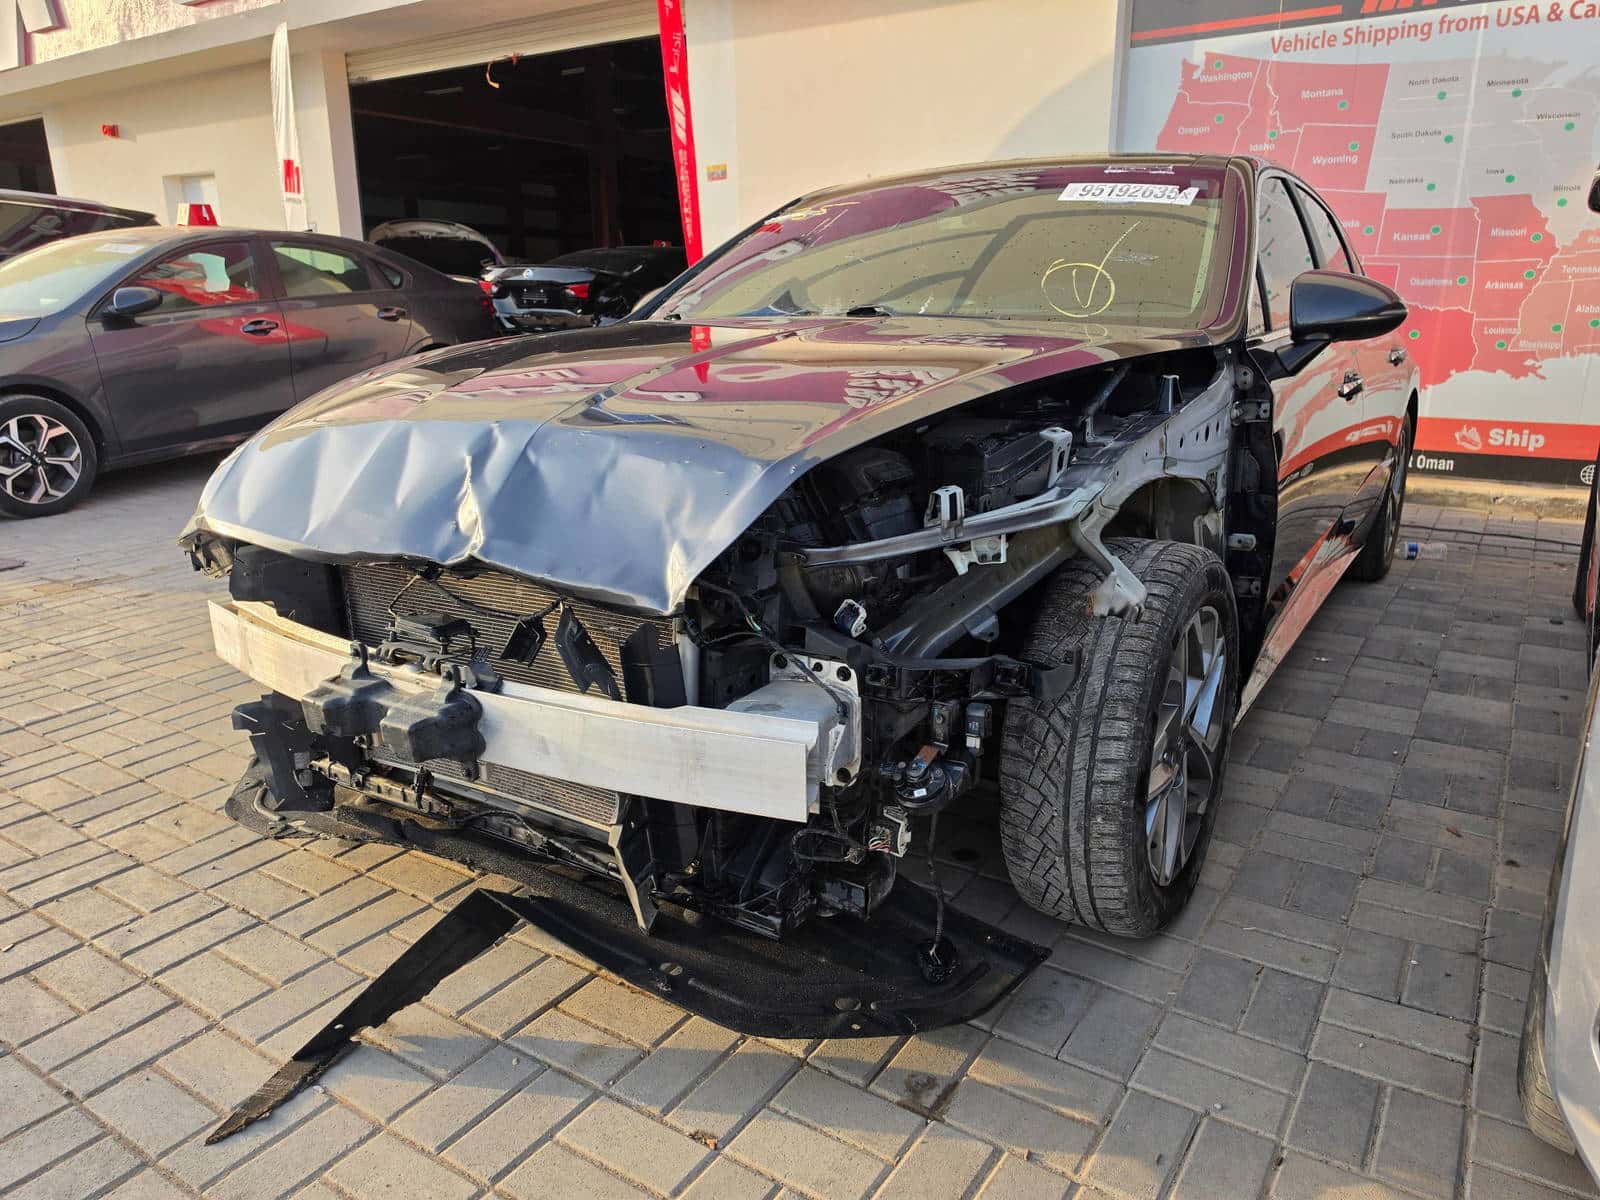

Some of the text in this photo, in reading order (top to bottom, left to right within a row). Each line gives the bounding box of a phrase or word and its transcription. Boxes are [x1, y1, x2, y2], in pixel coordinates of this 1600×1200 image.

[1270, 0, 1600, 54] Vehicle Shipping from USA & Ca
[1200, 71, 1253, 82] Washington
[1301, 88, 1344, 98] Montana
[1178, 126, 1210, 136] Oregon
[1312, 155, 1359, 165] Wyoming
[1393, 232, 1431, 241] Kansas
[1491, 228, 1527, 237] Missouri
[1485, 280, 1524, 290] Arkansas
[1487, 428, 1546, 452] Ship
[1416, 454, 1455, 471] Oman
